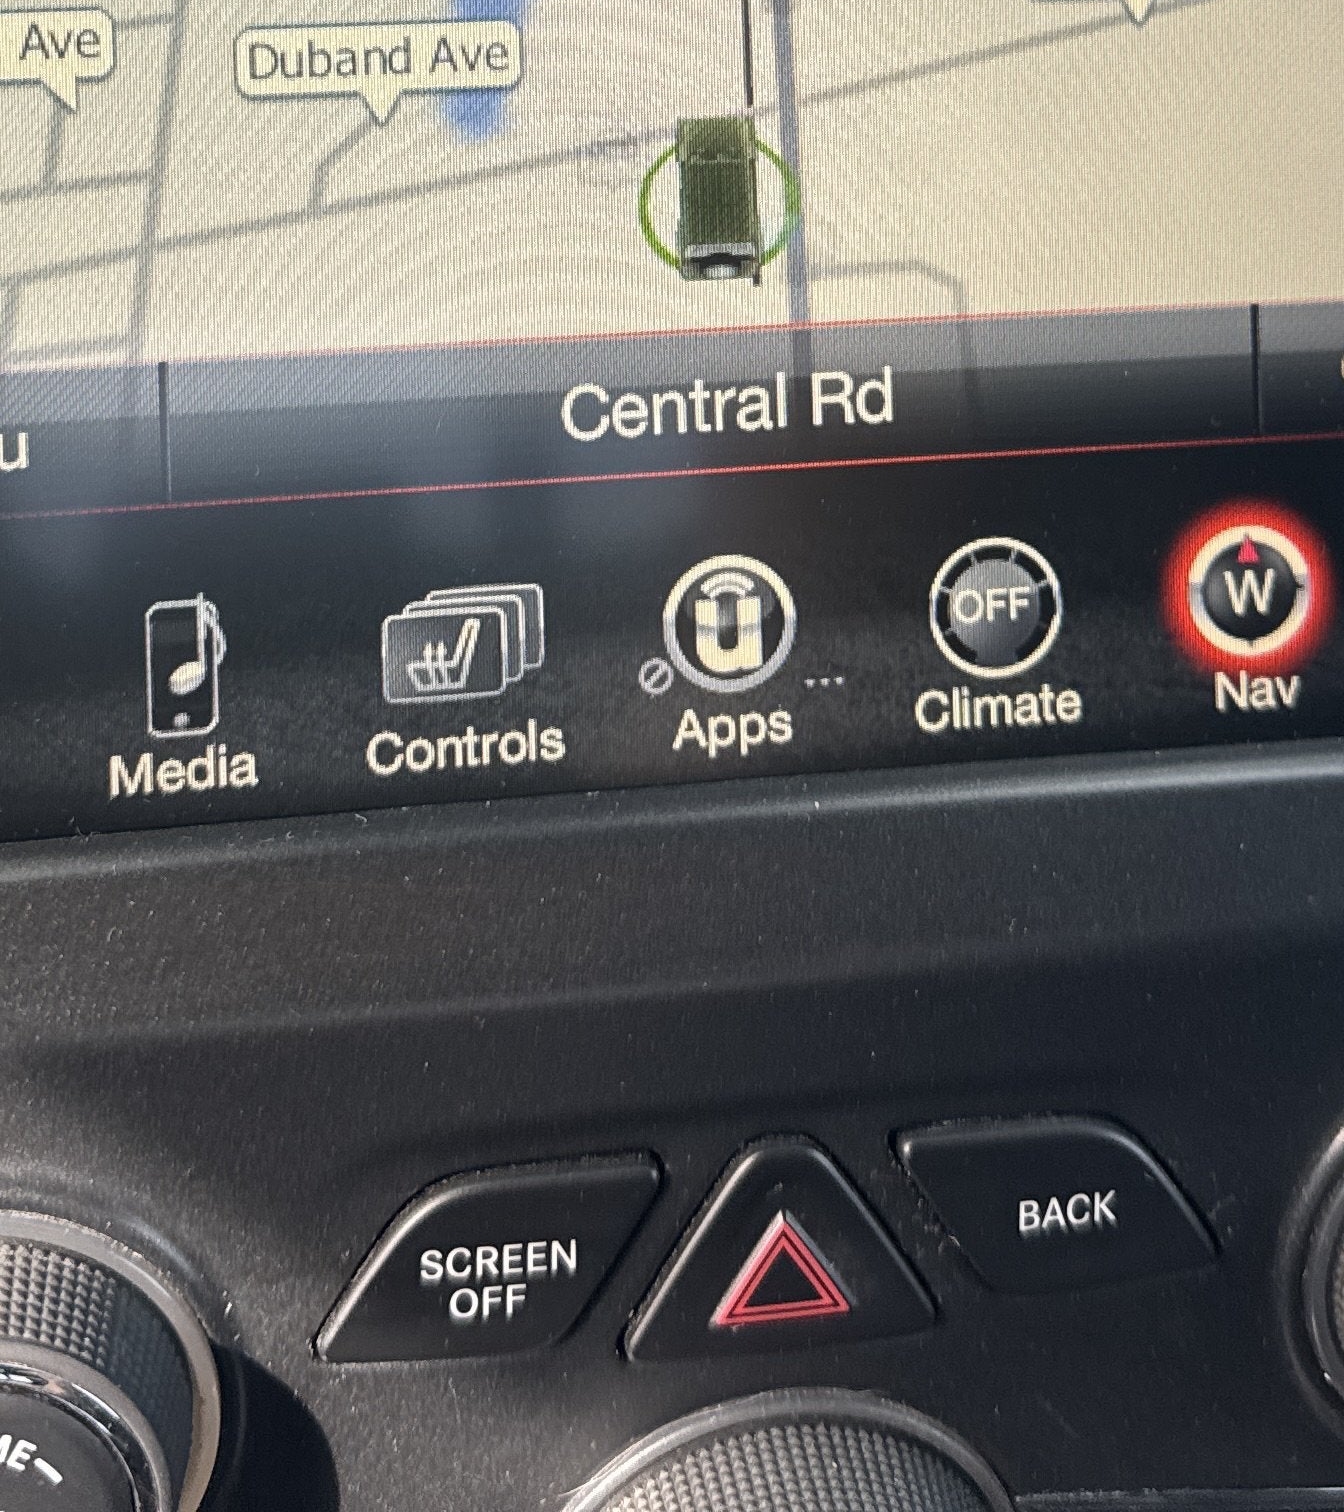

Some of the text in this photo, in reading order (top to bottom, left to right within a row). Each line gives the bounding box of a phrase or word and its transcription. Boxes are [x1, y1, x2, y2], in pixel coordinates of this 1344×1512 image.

[19, 22, 102, 61] Ave
[248, 35, 510, 81] Duband Ave
[561, 364, 896, 441] Central Rd
[951, 588, 1031, 626] OFF
[1221, 568, 1278, 619] W
[914, 686, 1084, 734] Climate
[1214, 670, 1303, 714] Nav
[365, 720, 567, 778] Controls
[671, 708, 794, 756] Apps
[107, 748, 258, 800] Media
[1017, 1191, 1118, 1231] BACK
[419, 1238, 578, 1282] SCREEN
[448, 1284, 528, 1321] OFF
